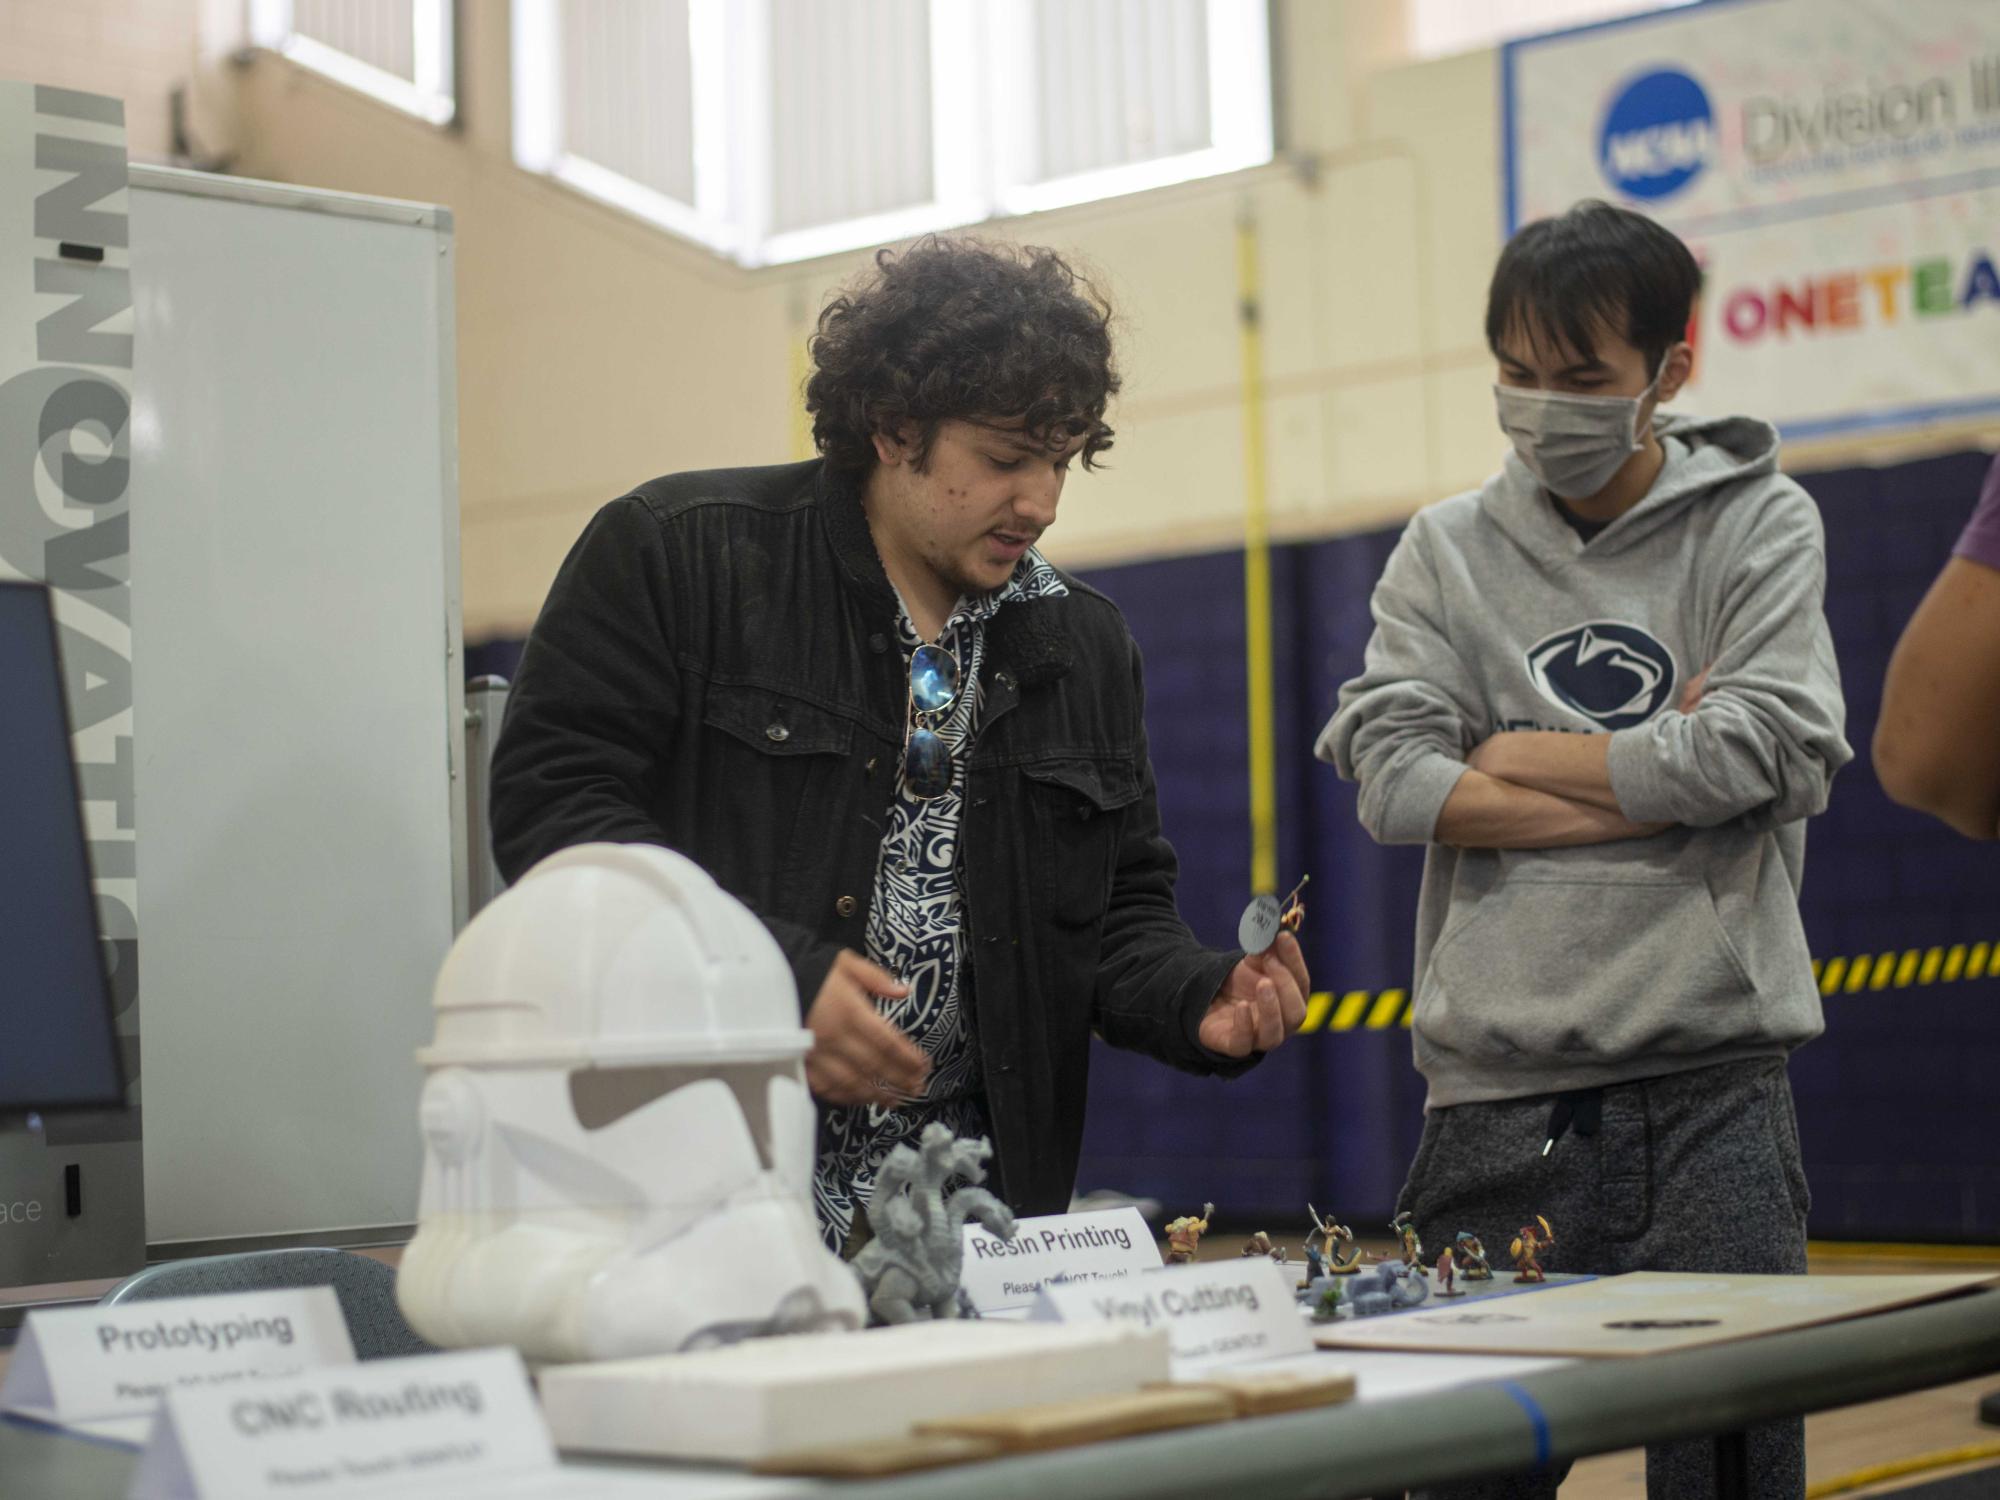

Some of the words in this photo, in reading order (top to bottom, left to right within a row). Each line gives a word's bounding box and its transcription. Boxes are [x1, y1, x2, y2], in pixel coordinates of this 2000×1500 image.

[1741, 74, 1957, 165] Division
[971, 1234, 1040, 1259] Resin
[1042, 1224, 1132, 1252] Printing
[1091, 1292, 1155, 1328] Vinyl
[1160, 1281, 1260, 1316] Cutting
[98, 1313, 295, 1354] Prototyping
[230, 1391, 325, 1438] CNC
[331, 1380, 485, 1421] Routing
